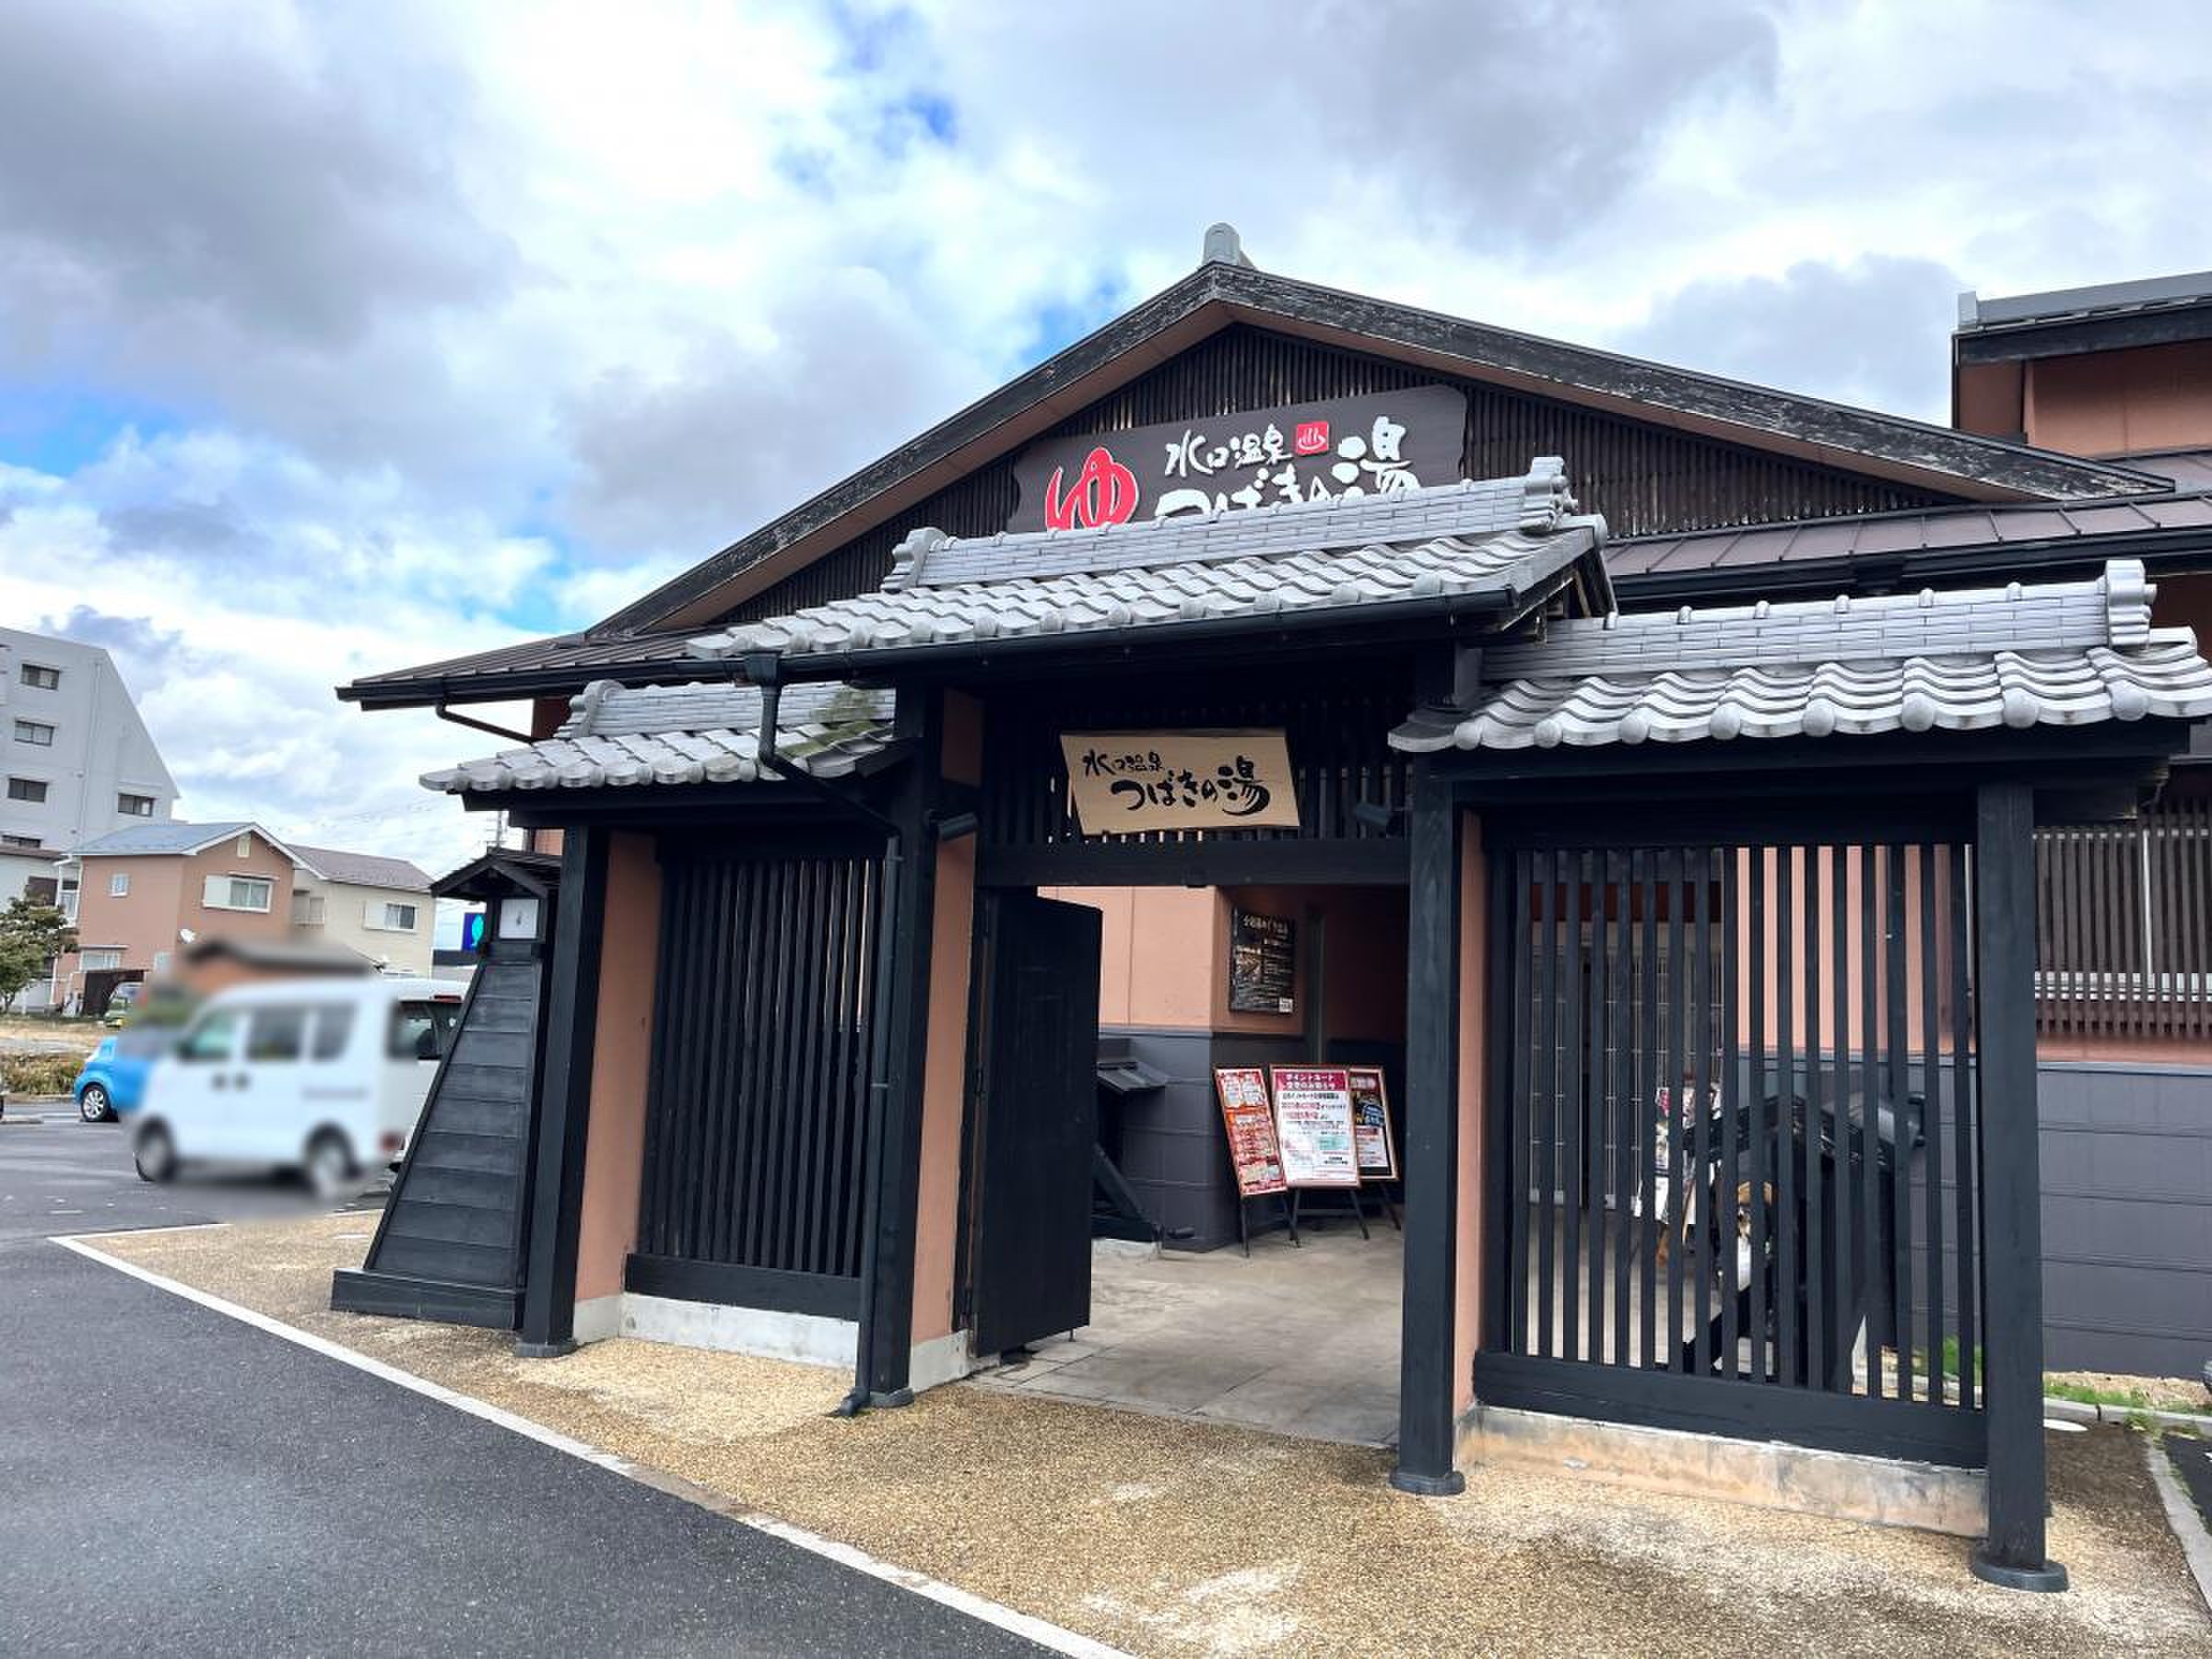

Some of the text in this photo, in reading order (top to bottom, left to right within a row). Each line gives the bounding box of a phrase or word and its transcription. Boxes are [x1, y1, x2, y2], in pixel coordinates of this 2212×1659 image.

[1164, 423, 1292, 478] 水口温泉
[1045, 446, 1139, 531] ゆ
[1082, 748, 1164, 777] 水口温泉
[1111, 754, 1271, 817] つばきの湯
